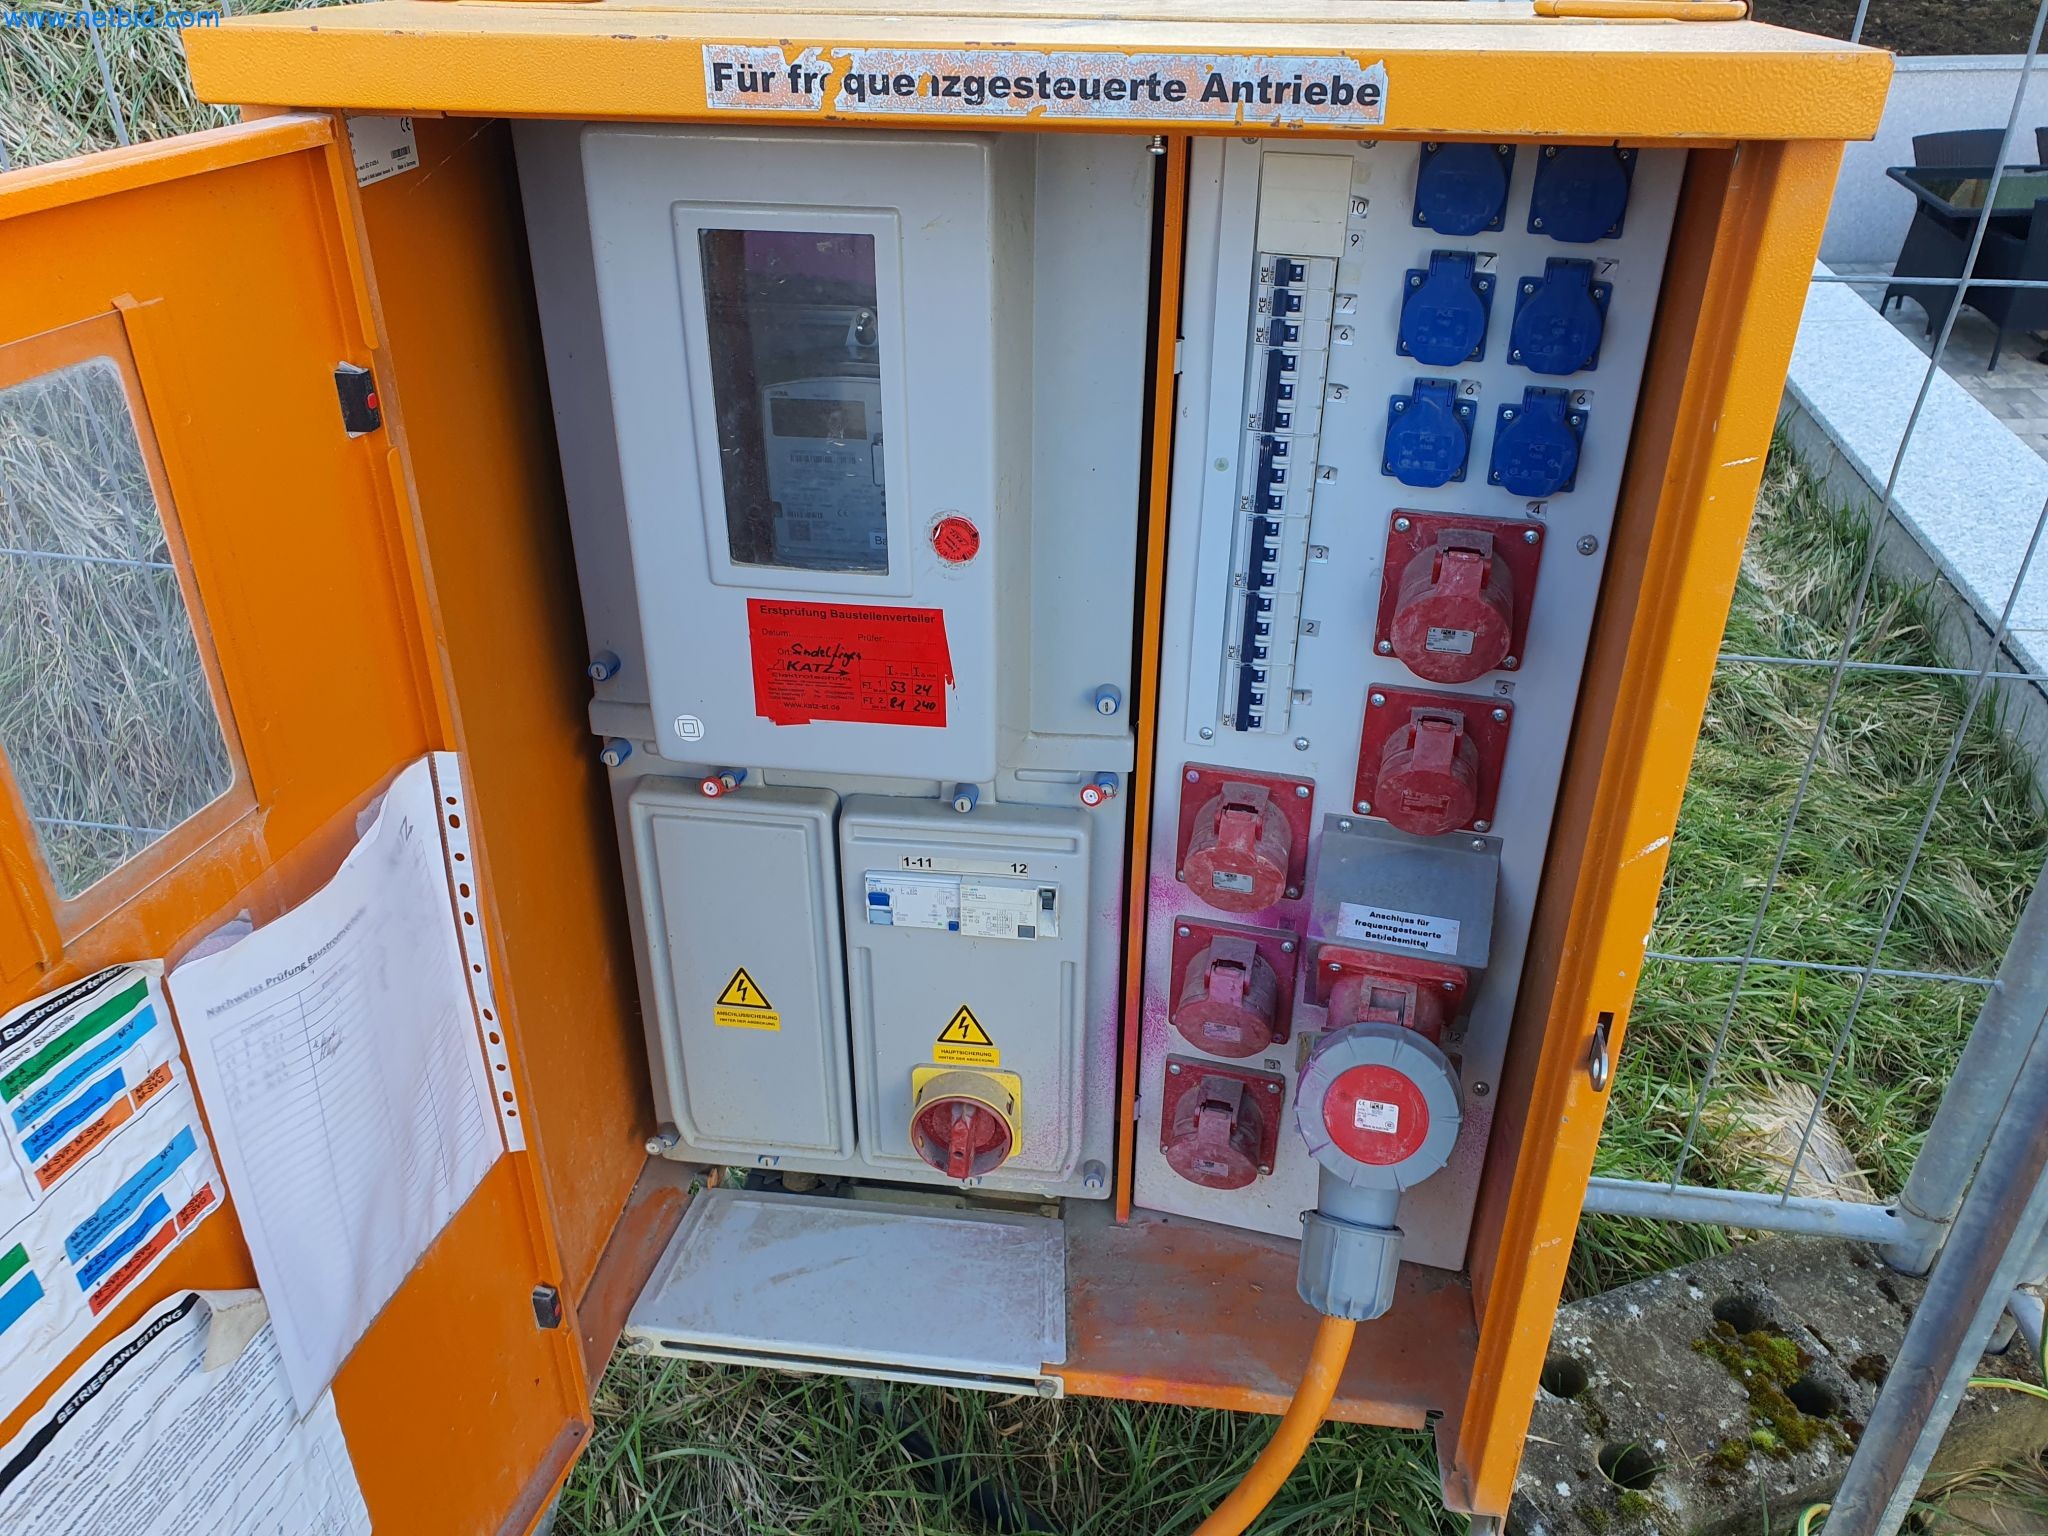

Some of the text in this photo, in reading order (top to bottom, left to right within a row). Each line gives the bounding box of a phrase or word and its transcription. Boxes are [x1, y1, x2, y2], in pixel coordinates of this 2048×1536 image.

[712, 62, 775, 93] Für
[1200, 72, 1381, 106] Antriebe
[1351, 200, 1366, 215] 10
[1351, 234, 1359, 248] 9
[1482, 255, 1495, 269] 7
[1600, 262, 1613, 275] 7
[1260, 267, 1269, 283] PCE
[1258, 297, 1267, 313] PCE
[1343, 296, 1353, 310] 7
[1256, 327, 1264, 343] PCE
[1340, 327, 1349, 341] 6
[1333, 387, 1343, 401] 5
[1465, 383, 1475, 396] 6
[1576, 392, 1586, 405] 6
[1248, 413, 1256, 428] PCE
[1322, 469, 1332, 482] 4
[1241, 496, 1249, 510] PCE
[1532, 504, 1541, 516] 4
[1315, 548, 1324, 560] 3
[1234, 573, 1242, 586] PCE
[760, 604, 935, 624] Erstprüfung Baustellenverteiler
[1305, 622, 1315, 634] 2
[786, 661, 836, 674] KATZ
[890, 681, 906, 693] 53
[914, 684, 933, 697] 24
[1499, 684, 1509, 696] 5
[1300, 692, 1307, 703] 1
[913, 700, 936, 712] 240
[903, 856, 932, 868] 1-11
[1010, 862, 1028, 874] 12
[1370, 911, 1430, 927] Anschluss für
[1354, 919, 1442, 940] frequenzgesteuerte
[1365, 931, 1429, 948] Betriebsmittel
[206, 983, 264, 1017] Nachweiss
[265, 961, 307, 988] Prüfung
[117, 1021, 135, 1039] M-V
[1448, 1031, 1462, 1042] 12
[941, 1048, 992, 1057] HAUPTSICHERUNG
[1269, 1061, 1277, 1070] 3
[160, 1142, 175, 1162] M-V
[69, 1213, 100, 1244] M-VEV
[83, 1251, 107, 1276] M-EV
[56, 1308, 183, 1425] BETRIEBSANLEITUNG
